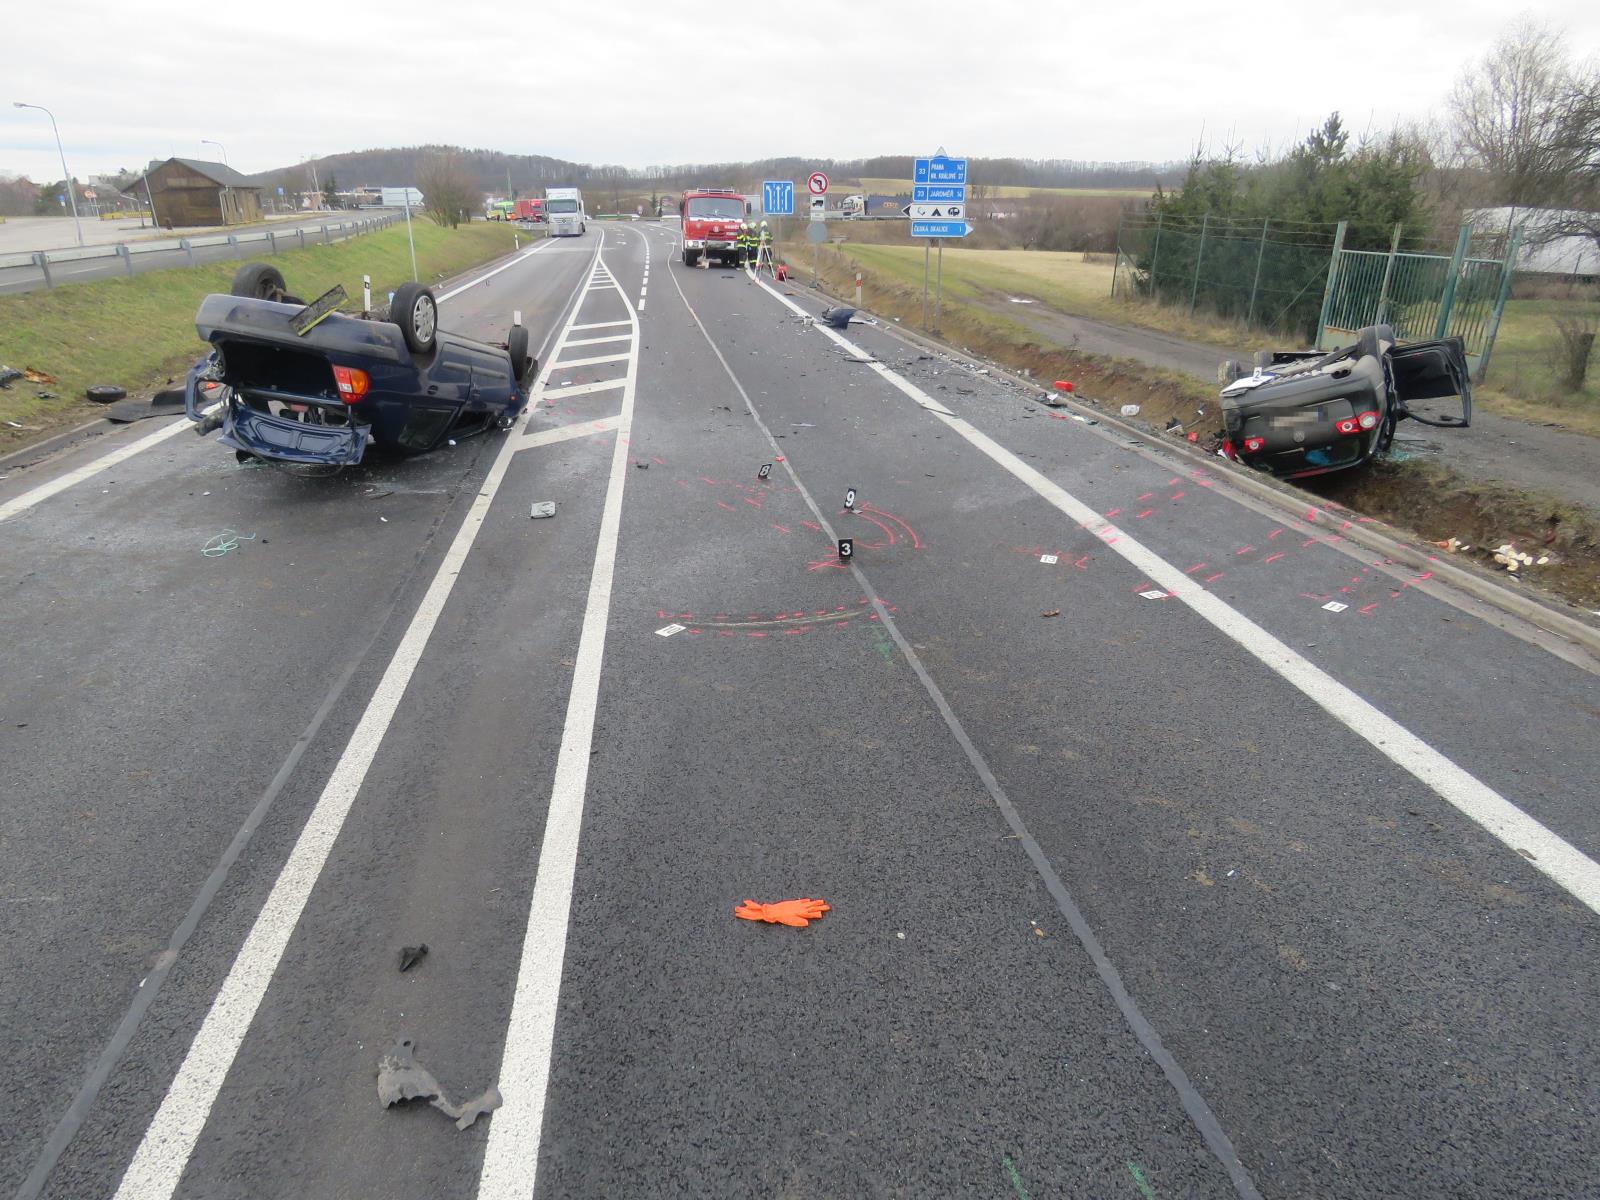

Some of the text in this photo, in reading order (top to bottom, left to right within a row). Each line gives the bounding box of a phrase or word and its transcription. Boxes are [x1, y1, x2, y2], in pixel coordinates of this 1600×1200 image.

[1255, 371, 1260, 379] 2
[760, 465, 769, 476] 8
[845, 491, 855, 507] 9
[841, 543, 851, 555] 3
